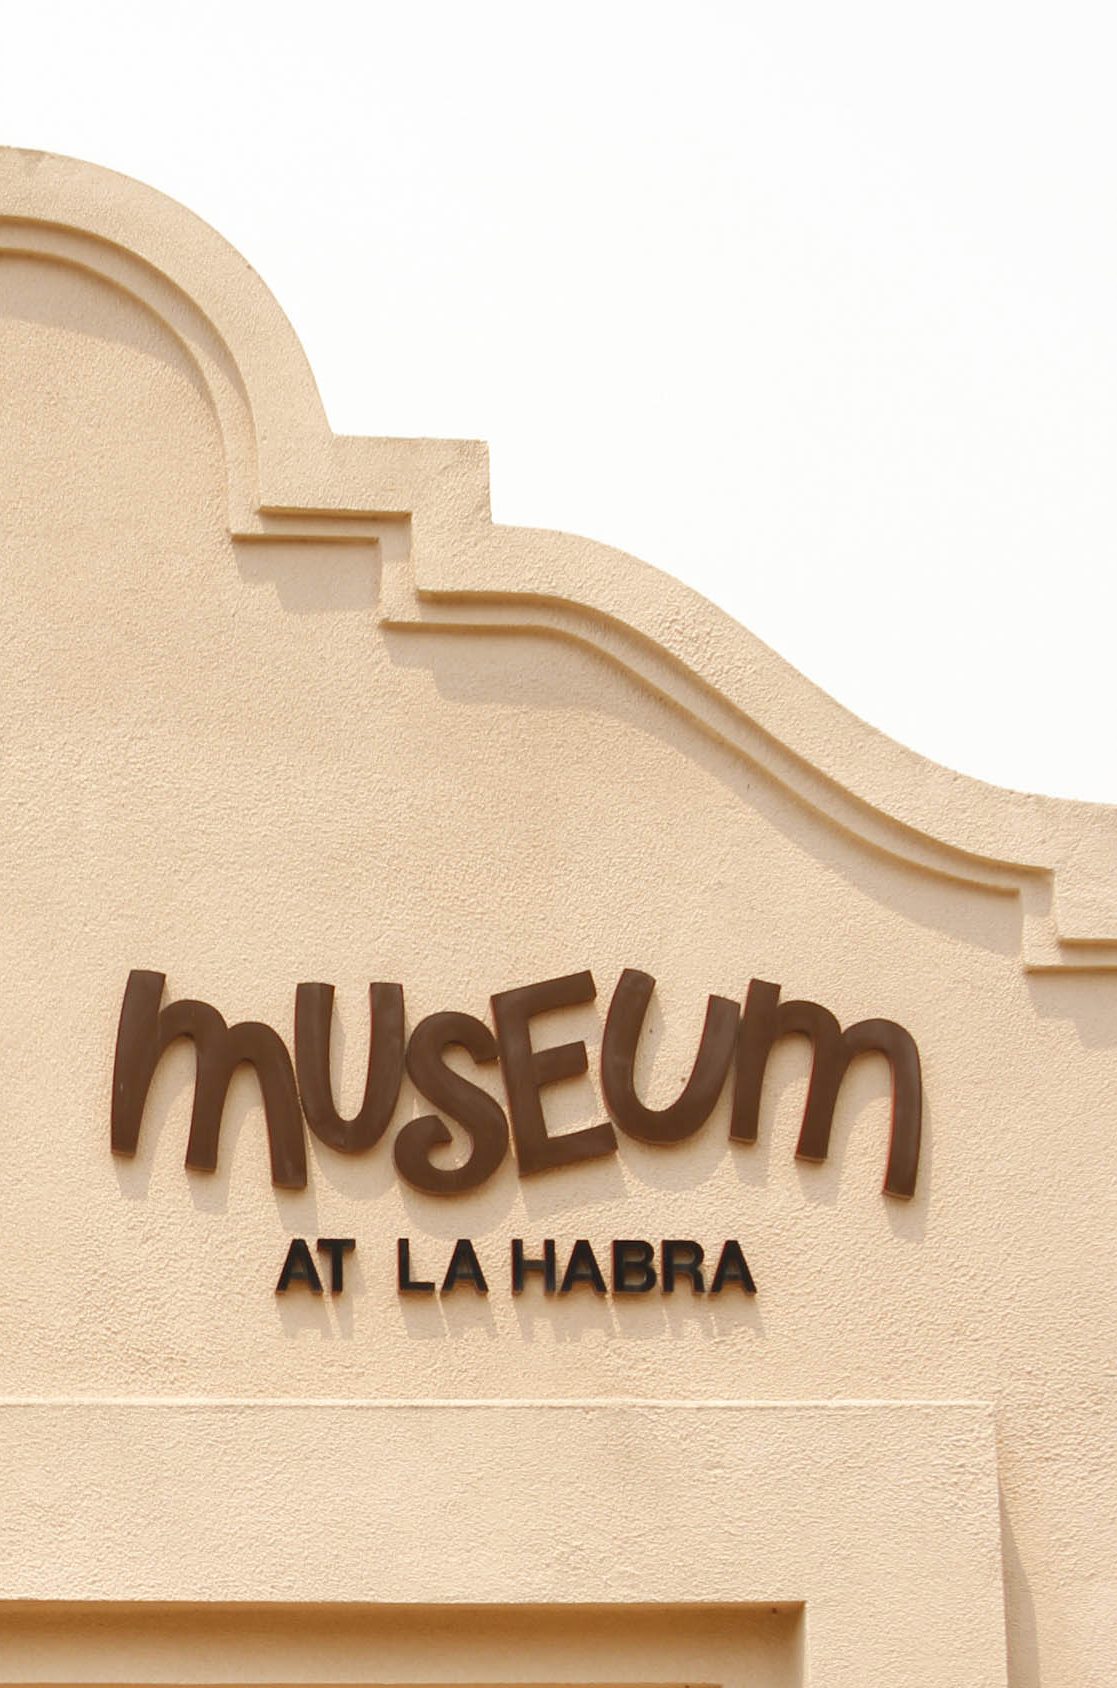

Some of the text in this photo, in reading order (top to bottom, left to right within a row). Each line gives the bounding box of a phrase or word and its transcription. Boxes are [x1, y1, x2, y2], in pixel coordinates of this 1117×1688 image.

[276, 1238, 758, 1293] AT LA HABRA
